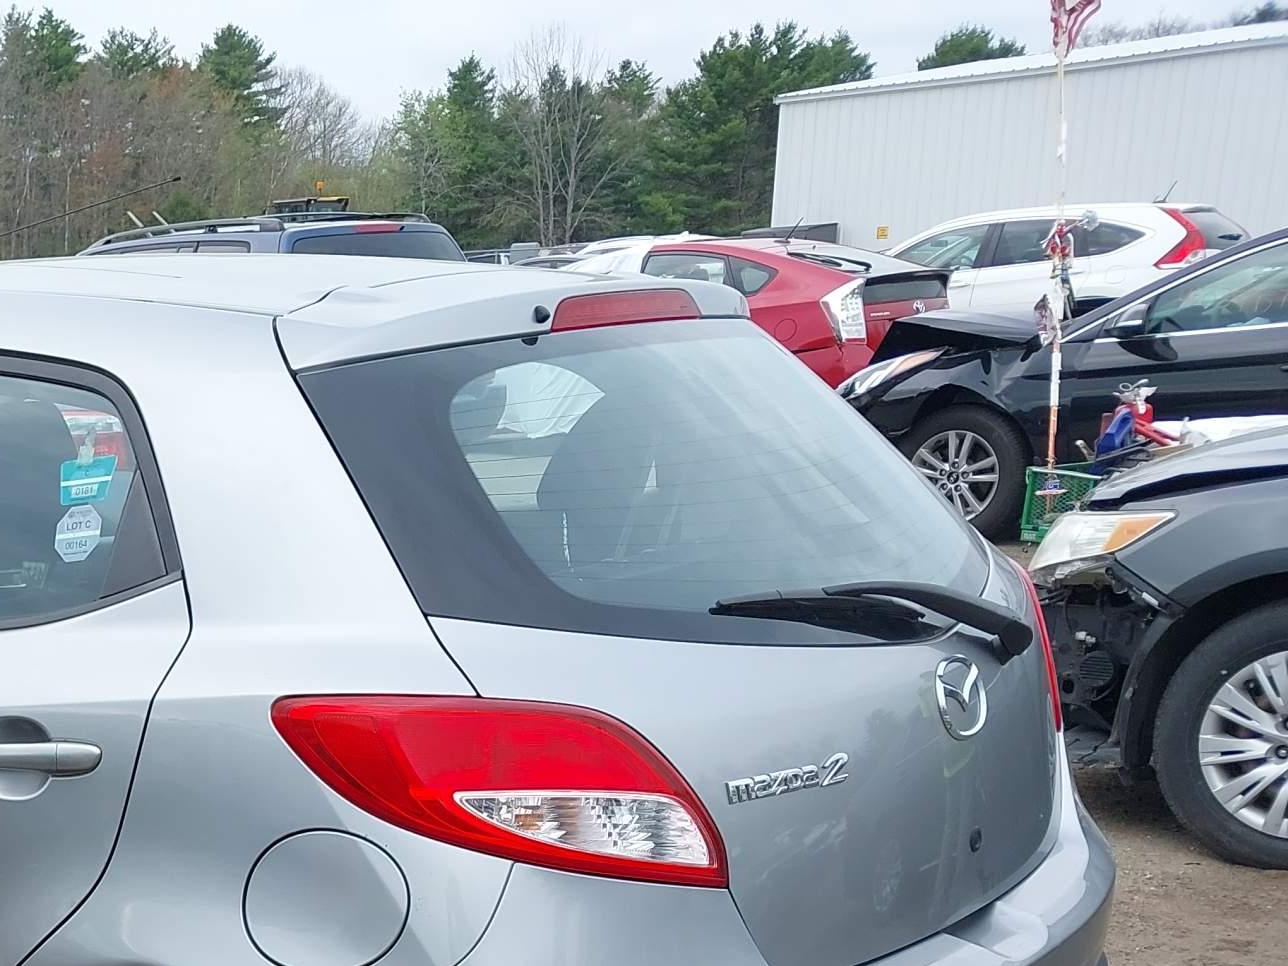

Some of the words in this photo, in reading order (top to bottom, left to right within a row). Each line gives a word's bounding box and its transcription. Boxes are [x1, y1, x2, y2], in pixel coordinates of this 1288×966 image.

[66, 520, 82, 532] LOT
[85, 519, 92, 529] C
[65, 539, 88, 550] 00164
